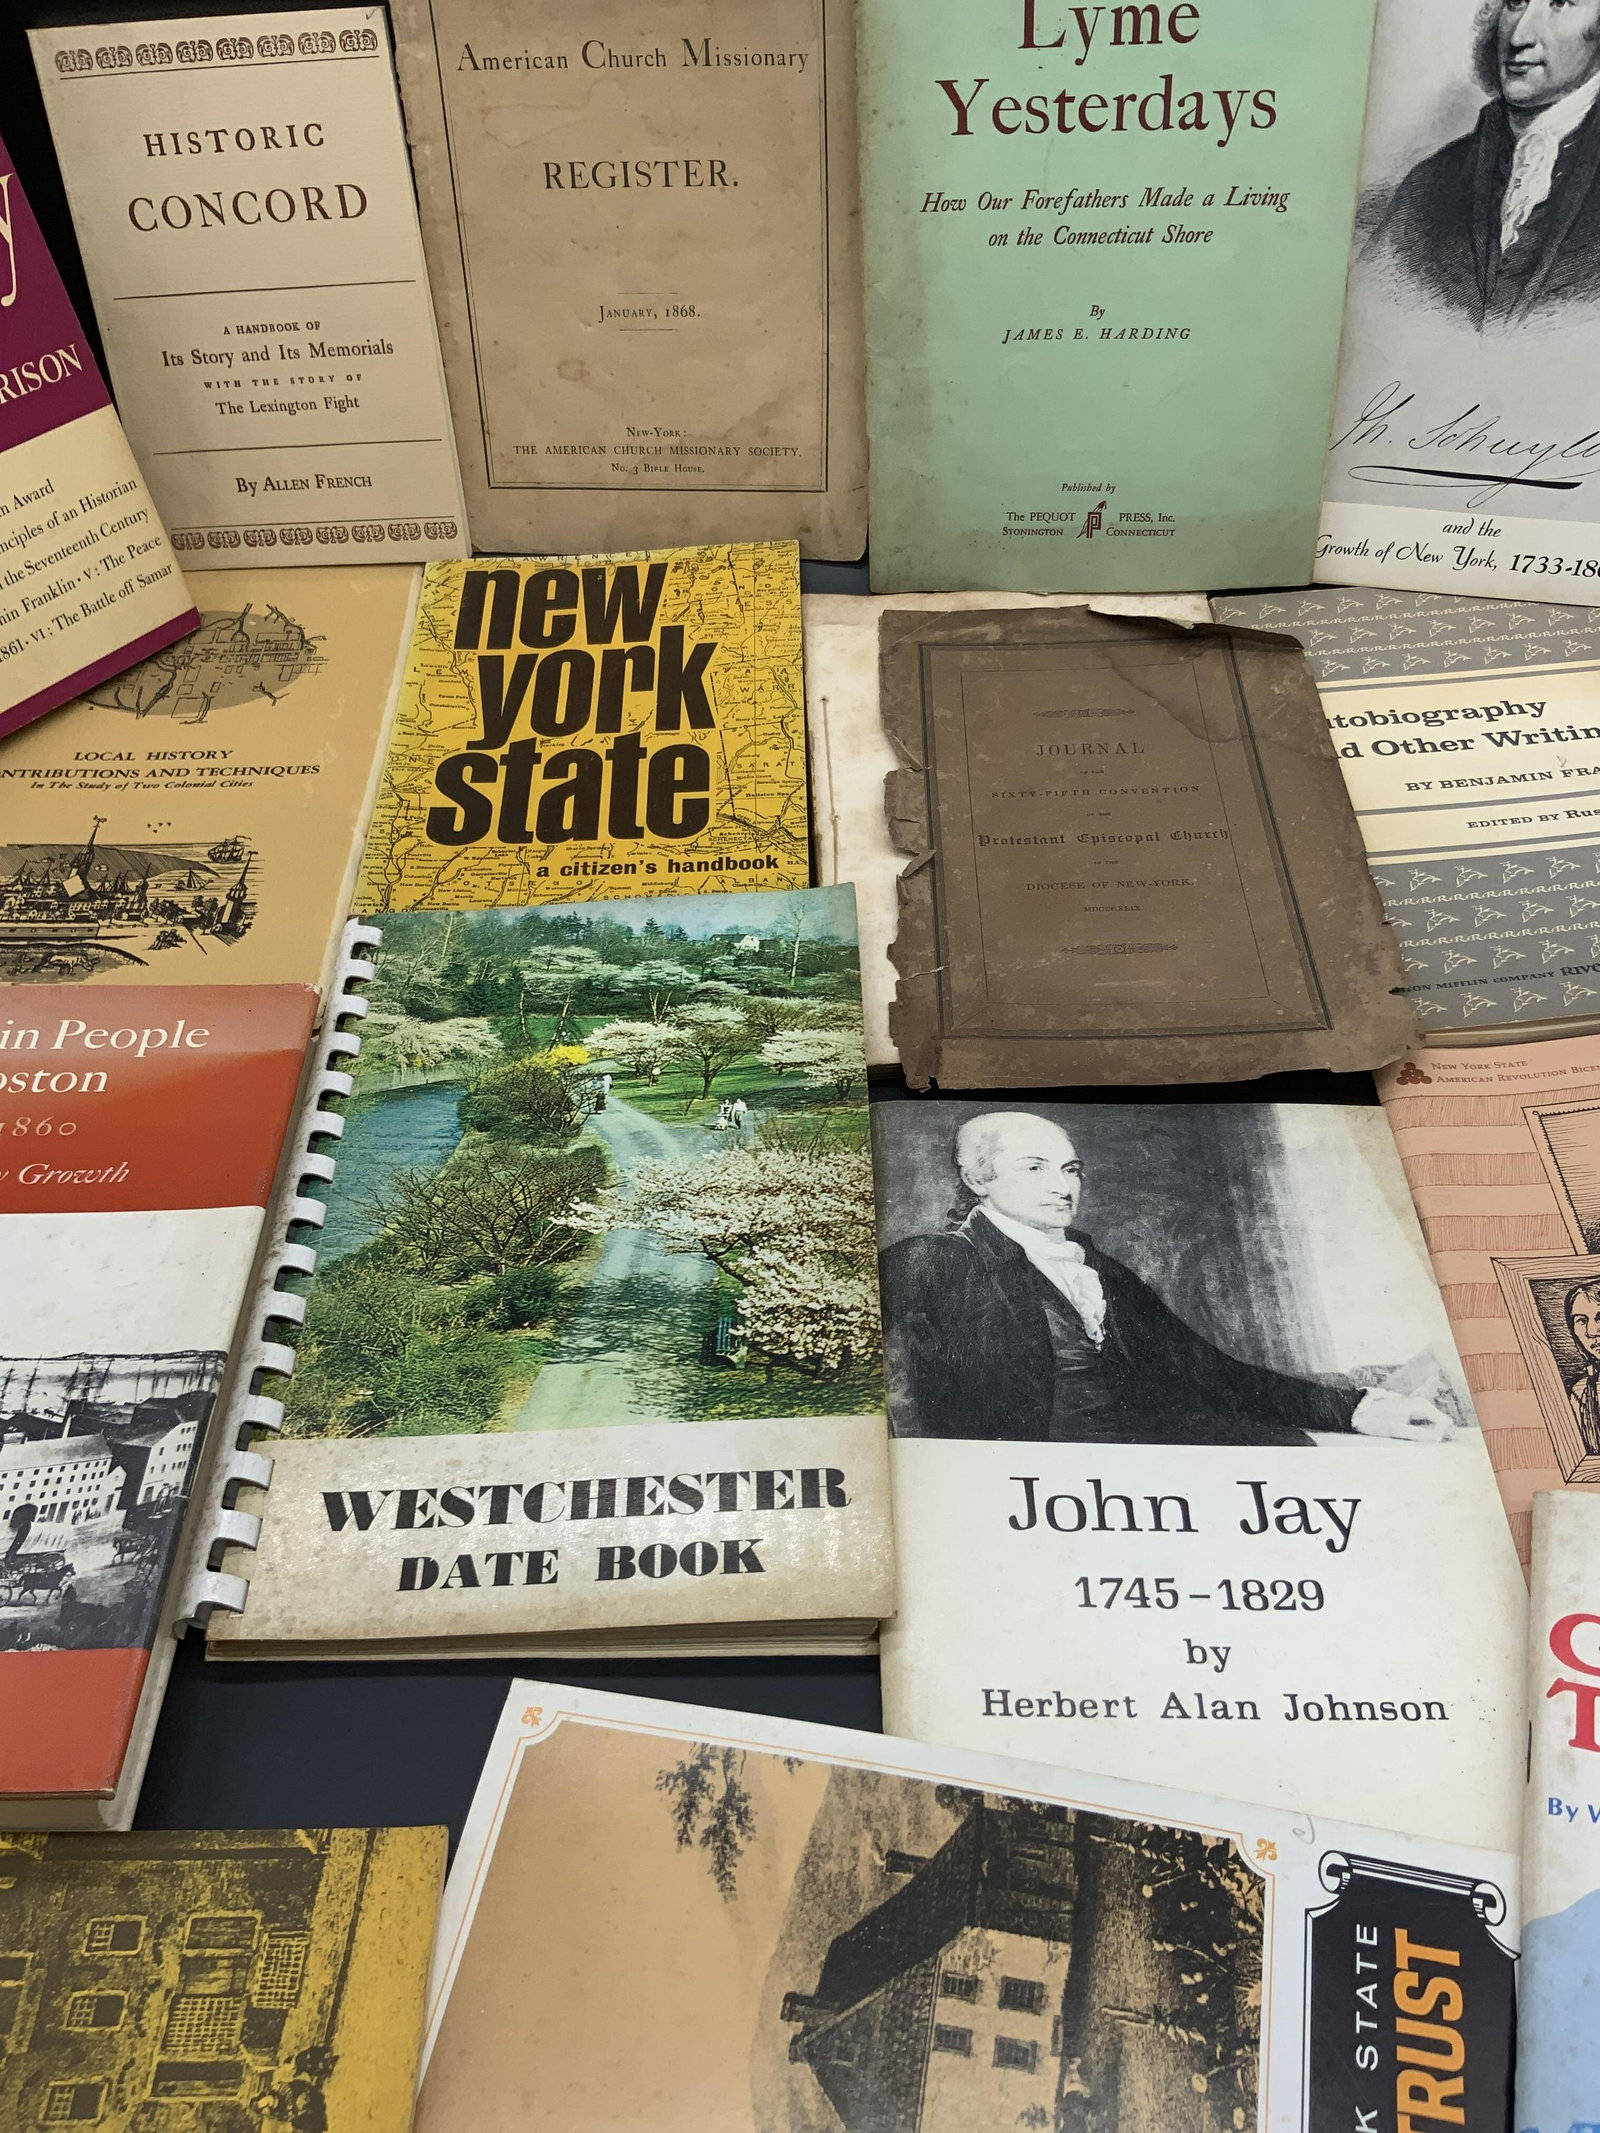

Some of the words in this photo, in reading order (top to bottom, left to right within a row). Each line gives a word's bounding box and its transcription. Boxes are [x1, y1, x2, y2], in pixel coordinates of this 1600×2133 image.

[1017, 0, 1200, 66] Lyme
[457, 42, 569, 72] American
[581, 38, 667, 70] Church
[681, 37, 809, 73] Missionary
[934, 73, 1277, 148] Yesterdays
[142, 122, 326, 158] HISTORIC
[543, 158, 740, 191] REGISTER.
[127, 182, 369, 233] CONCORD
[920, 191, 967, 213] How
[977, 191, 1013, 211] Our
[1020, 188, 1128, 215] Forefathers
[1138, 187, 1194, 208] Made
[1202, 193, 1215, 207] a
[1224, 185, 1291, 213] Living
[988, 231, 1008, 247] on
[1016, 227, 1043, 246] the
[1052, 225, 1154, 246] Connecticut
[1161, 224, 1214, 245] Shore
[665, 304, 701, 319] 1868.
[1089, 304, 1106, 320] By
[223, 326, 231, 337] A
[236, 321, 300, 336] HANDBOOK
[305, 320, 321, 331] OF
[1001, 328, 1064, 344] JAMES
[1073, 328, 1089, 340] E.
[1099, 327, 1192, 341] HARDING
[162, 349, 184, 368] Its
[191, 346, 234, 369] Story
[241, 345, 271, 364] and
[278, 343, 301, 362] Its
[309, 339, 394, 360] Memorials
[251, 377, 280, 387] THE
[215, 400, 245, 416] The
[249, 396, 318, 418] Lexington
[323, 394, 360, 413] Fight
[512, 444, 538, 456] THE
[545, 445, 607, 457] AMERICAN
[613, 445, 663, 457] CHURCH
[669, 446, 741, 458] MISSIONARY
[13, 478, 55, 510] Award
[235, 476, 257, 498] By
[262, 474, 310, 492] ALLEN
[314, 471, 373, 491] FRENCH
[1061, 483, 1101, 492] Published
[1105, 483, 1116, 494] by
[47, 511, 59, 531] of
[63, 508, 78, 523] an
[78, 479, 137, 512] Historian
[1006, 512, 1025, 522] The
[1029, 512, 1077, 524] PEQUOT
[1119, 512, 1153, 523] PRESS,
[1158, 512, 1176, 522] Inc.
[1002, 527, 1064, 537] STONINGTON
[1106, 527, 1176, 537] CONNECTICUT
[1442, 518, 1474, 535] and
[1477, 518, 1502, 538] the
[4, 566, 25, 589] the
[24, 528, 100, 576] Seventeenth
[100, 507, 149, 538] Century
[1315, 534, 1369, 558] Growth
[1375, 542, 1394, 563] of
[1396, 542, 1443, 564] New
[1452, 545, 1497, 571] York,
[1509, 554, 1600, 578] 1733-18
[20, 577, 76, 613] Franklin
[100, 551, 128, 573] The
[129, 535, 162, 561] Peace
[52, 609, 81, 632] The
[82, 590, 117, 617] Battle
[118, 577, 136, 600] off
[136, 563, 173, 589] Samar
[453, 561, 668, 651] new
[466, 625, 718, 750] york
[73, 751, 136, 761] LOCAL
[146, 750, 234, 760] HISTORY
[1035, 742, 1145, 757] JOURNAL
[1371, 737, 1475, 757] Other
[49, 781, 73, 789] The
[75, 781, 111, 791] Study
[114, 781, 129, 791] of
[133, 781, 160, 789] Two
[164, 780, 216, 789] Colonial
[219, 779, 255, 788] Cities
[144, 767, 190, 778] AND
[195, 765, 321, 777] TECHNIQUES
[1405, 781, 1433, 791] BY
[1439, 771, 1553, 790] BENJAMIN
[425, 732, 710, 846] state
[1099, 784, 1201, 796] CONVENTION
[1467, 816, 1533, 829] EDITED
[1539, 813, 1560, 822] BY
[978, 834, 1065, 848] Protestant
[1077, 832, 1160, 847] Episcopal
[1169, 828, 1230, 842] Church
[536, 863, 550, 877] a
[560, 858, 657, 877] citizen's
[667, 854, 780, 876] handbook
[1026, 881, 1085, 891] DIOCESE
[1091, 881, 1109, 889] OF
[1436, 978, 1488, 989] MIFFLIN
[1493, 971, 1554, 983] COMPANY
[50, 1020, 210, 1058] People
[18, 1161, 130, 1185] Growth
[320, 1466, 852, 1533] WESTCHESTER
[1008, 1476, 1198, 1533] John
[1235, 1480, 1361, 1553] Jay
[396, 1549, 559, 1592] DATE
[595, 1538, 766, 1582] BOOK
[1183, 1638, 1231, 1672] by
[981, 1688, 1138, 1719] Herbert
[1160, 1691, 1261, 1720] Alan
[1283, 1692, 1450, 1722] Johnson
[1548, 1796, 1579, 1823] By
[1356, 1923, 1380, 2070] STATE
